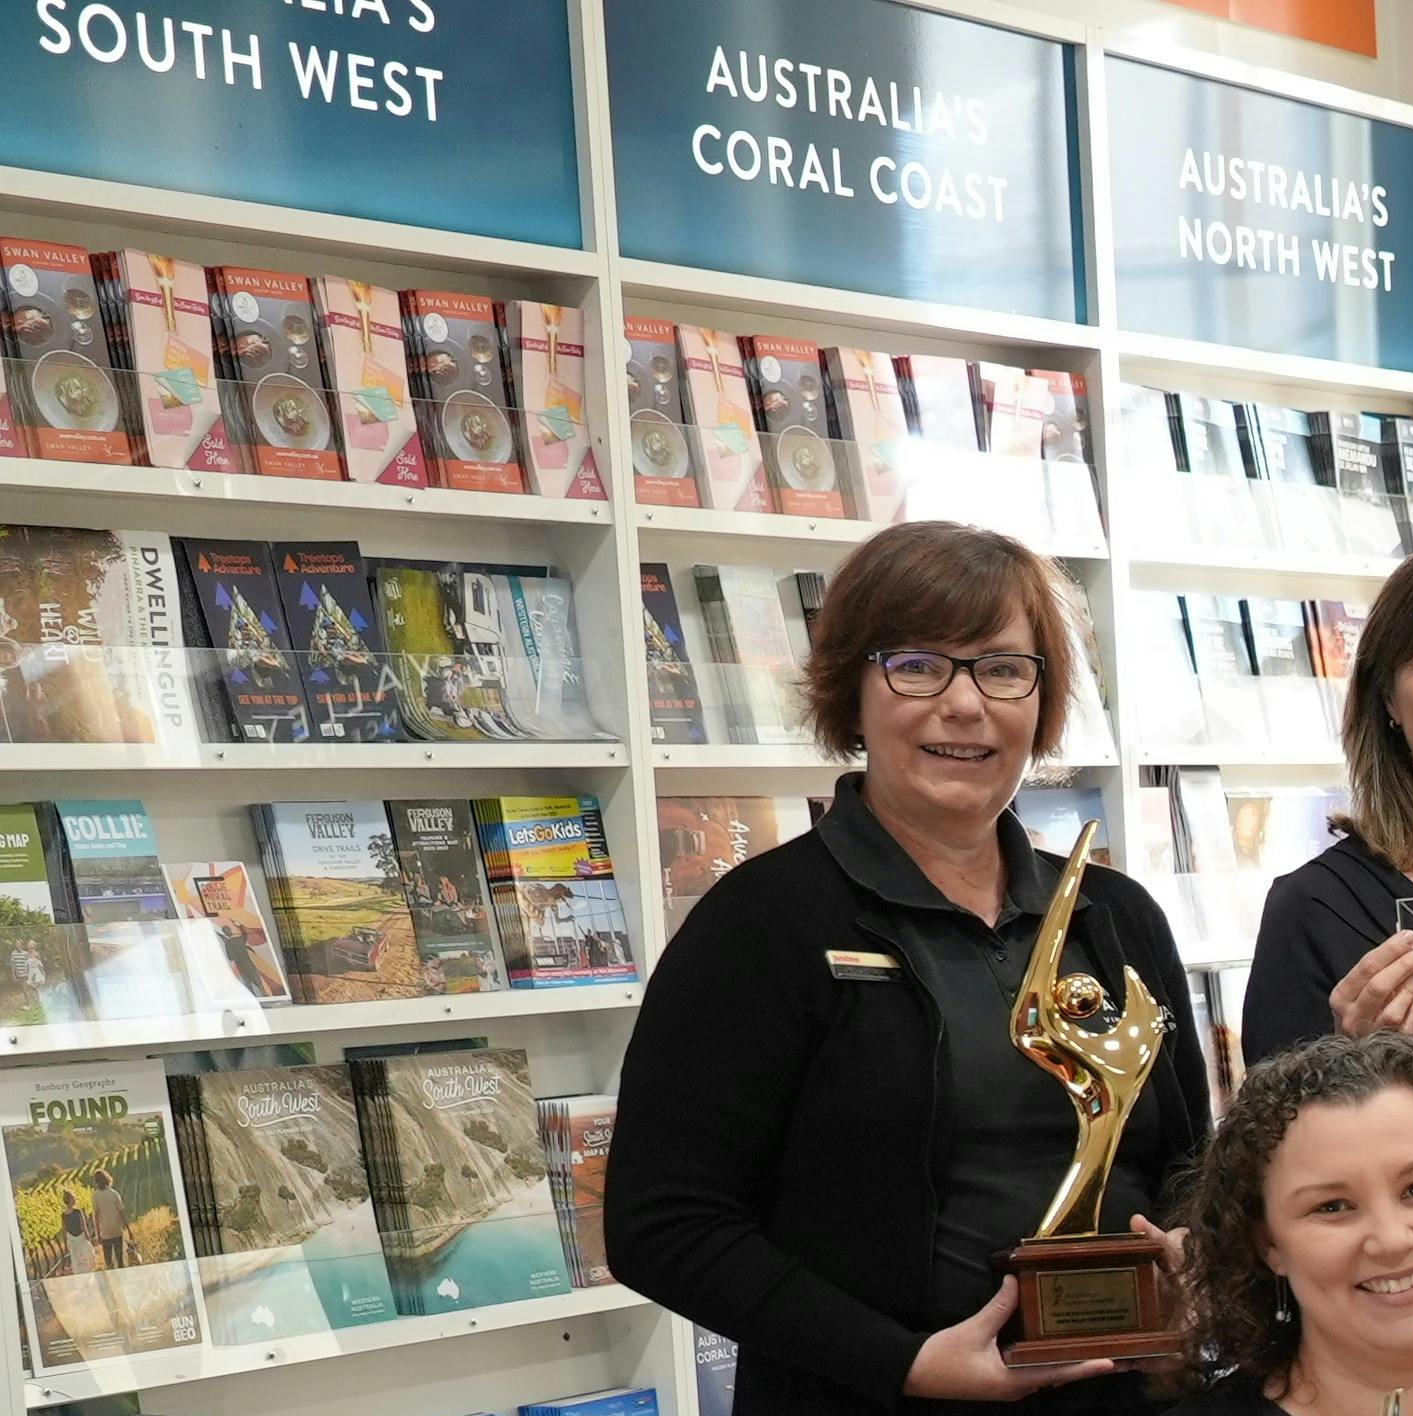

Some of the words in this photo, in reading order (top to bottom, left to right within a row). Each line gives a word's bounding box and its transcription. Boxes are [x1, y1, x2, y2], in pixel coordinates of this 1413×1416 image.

[38, 0, 262, 90] SOUTH
[288, 42, 443, 121] WEST
[706, 45, 988, 145] AUSTRALIA'S
[692, 124, 854, 197] CORAL
[870, 156, 1007, 222] COAST
[1179, 148, 1389, 228] AUSTRALIA'S
[4, 247, 39, 259] SWAN
[44, 251, 87, 265] VALLEY
[1178, 216, 1300, 277] NORTH
[1312, 238, 1395, 292] WEST
[227, 275, 261, 287] SWAN
[264, 278, 304, 293] VALLEY
[420, 297, 450, 309] SWAN
[452, 300, 489, 313] VALLEY
[637, 323, 671, 335] VALLEY
[757, 341, 782, 353] SWAN
[784, 344, 816, 355] VALLEY
[202, 431, 225, 450] Sold
[205, 450, 230, 466] Here
[397, 451, 417, 467] Sold
[397, 466, 419, 482] Here
[213, 565, 261, 576] Adventure
[301, 564, 356, 575] Adventure
[39, 602, 69, 665] HEART
[141, 547, 182, 728] DWELLINGUP
[306, 813, 354, 824] FERGUSON
[406, 808, 453, 819] FERGUSON
[64, 814, 148, 841] COLLIE
[308, 822, 356, 839] VALLEY
[408, 817, 454, 832] VALLEY
[509, 819, 582, 846] LetsGoKids
[8, 834, 30, 848] MAP
[427, 1063, 494, 1078] AUSTRALIA'S
[243, 1079, 314, 1095] AUSTRALIA'S
[423, 1077, 463, 1109] South
[465, 1074, 501, 1096] West
[30, 1095, 128, 1127] FOUND
[237, 1095, 281, 1128] South
[283, 1090, 321, 1113] West
[171, 1315, 194, 1330] BUN
[174, 1327, 196, 1342] GEO
[697, 1348, 730, 1364] CORAL
